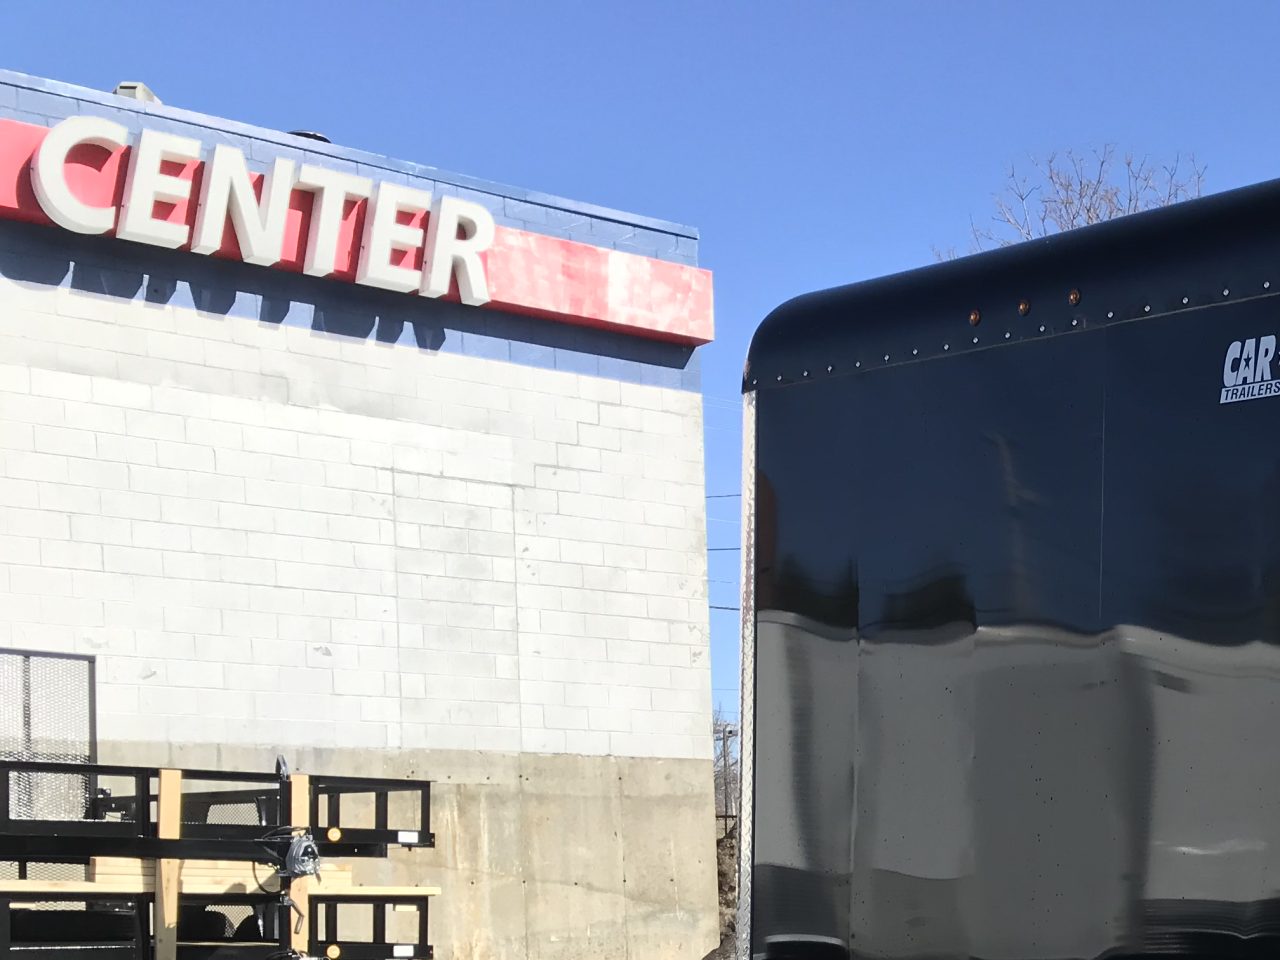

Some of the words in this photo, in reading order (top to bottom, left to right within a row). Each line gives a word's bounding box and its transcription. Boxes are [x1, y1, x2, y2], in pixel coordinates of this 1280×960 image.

[31, 115, 496, 306] CENTER
[1223, 334, 1277, 388] CAR
[1224, 381, 1280, 401] TRAILERS
